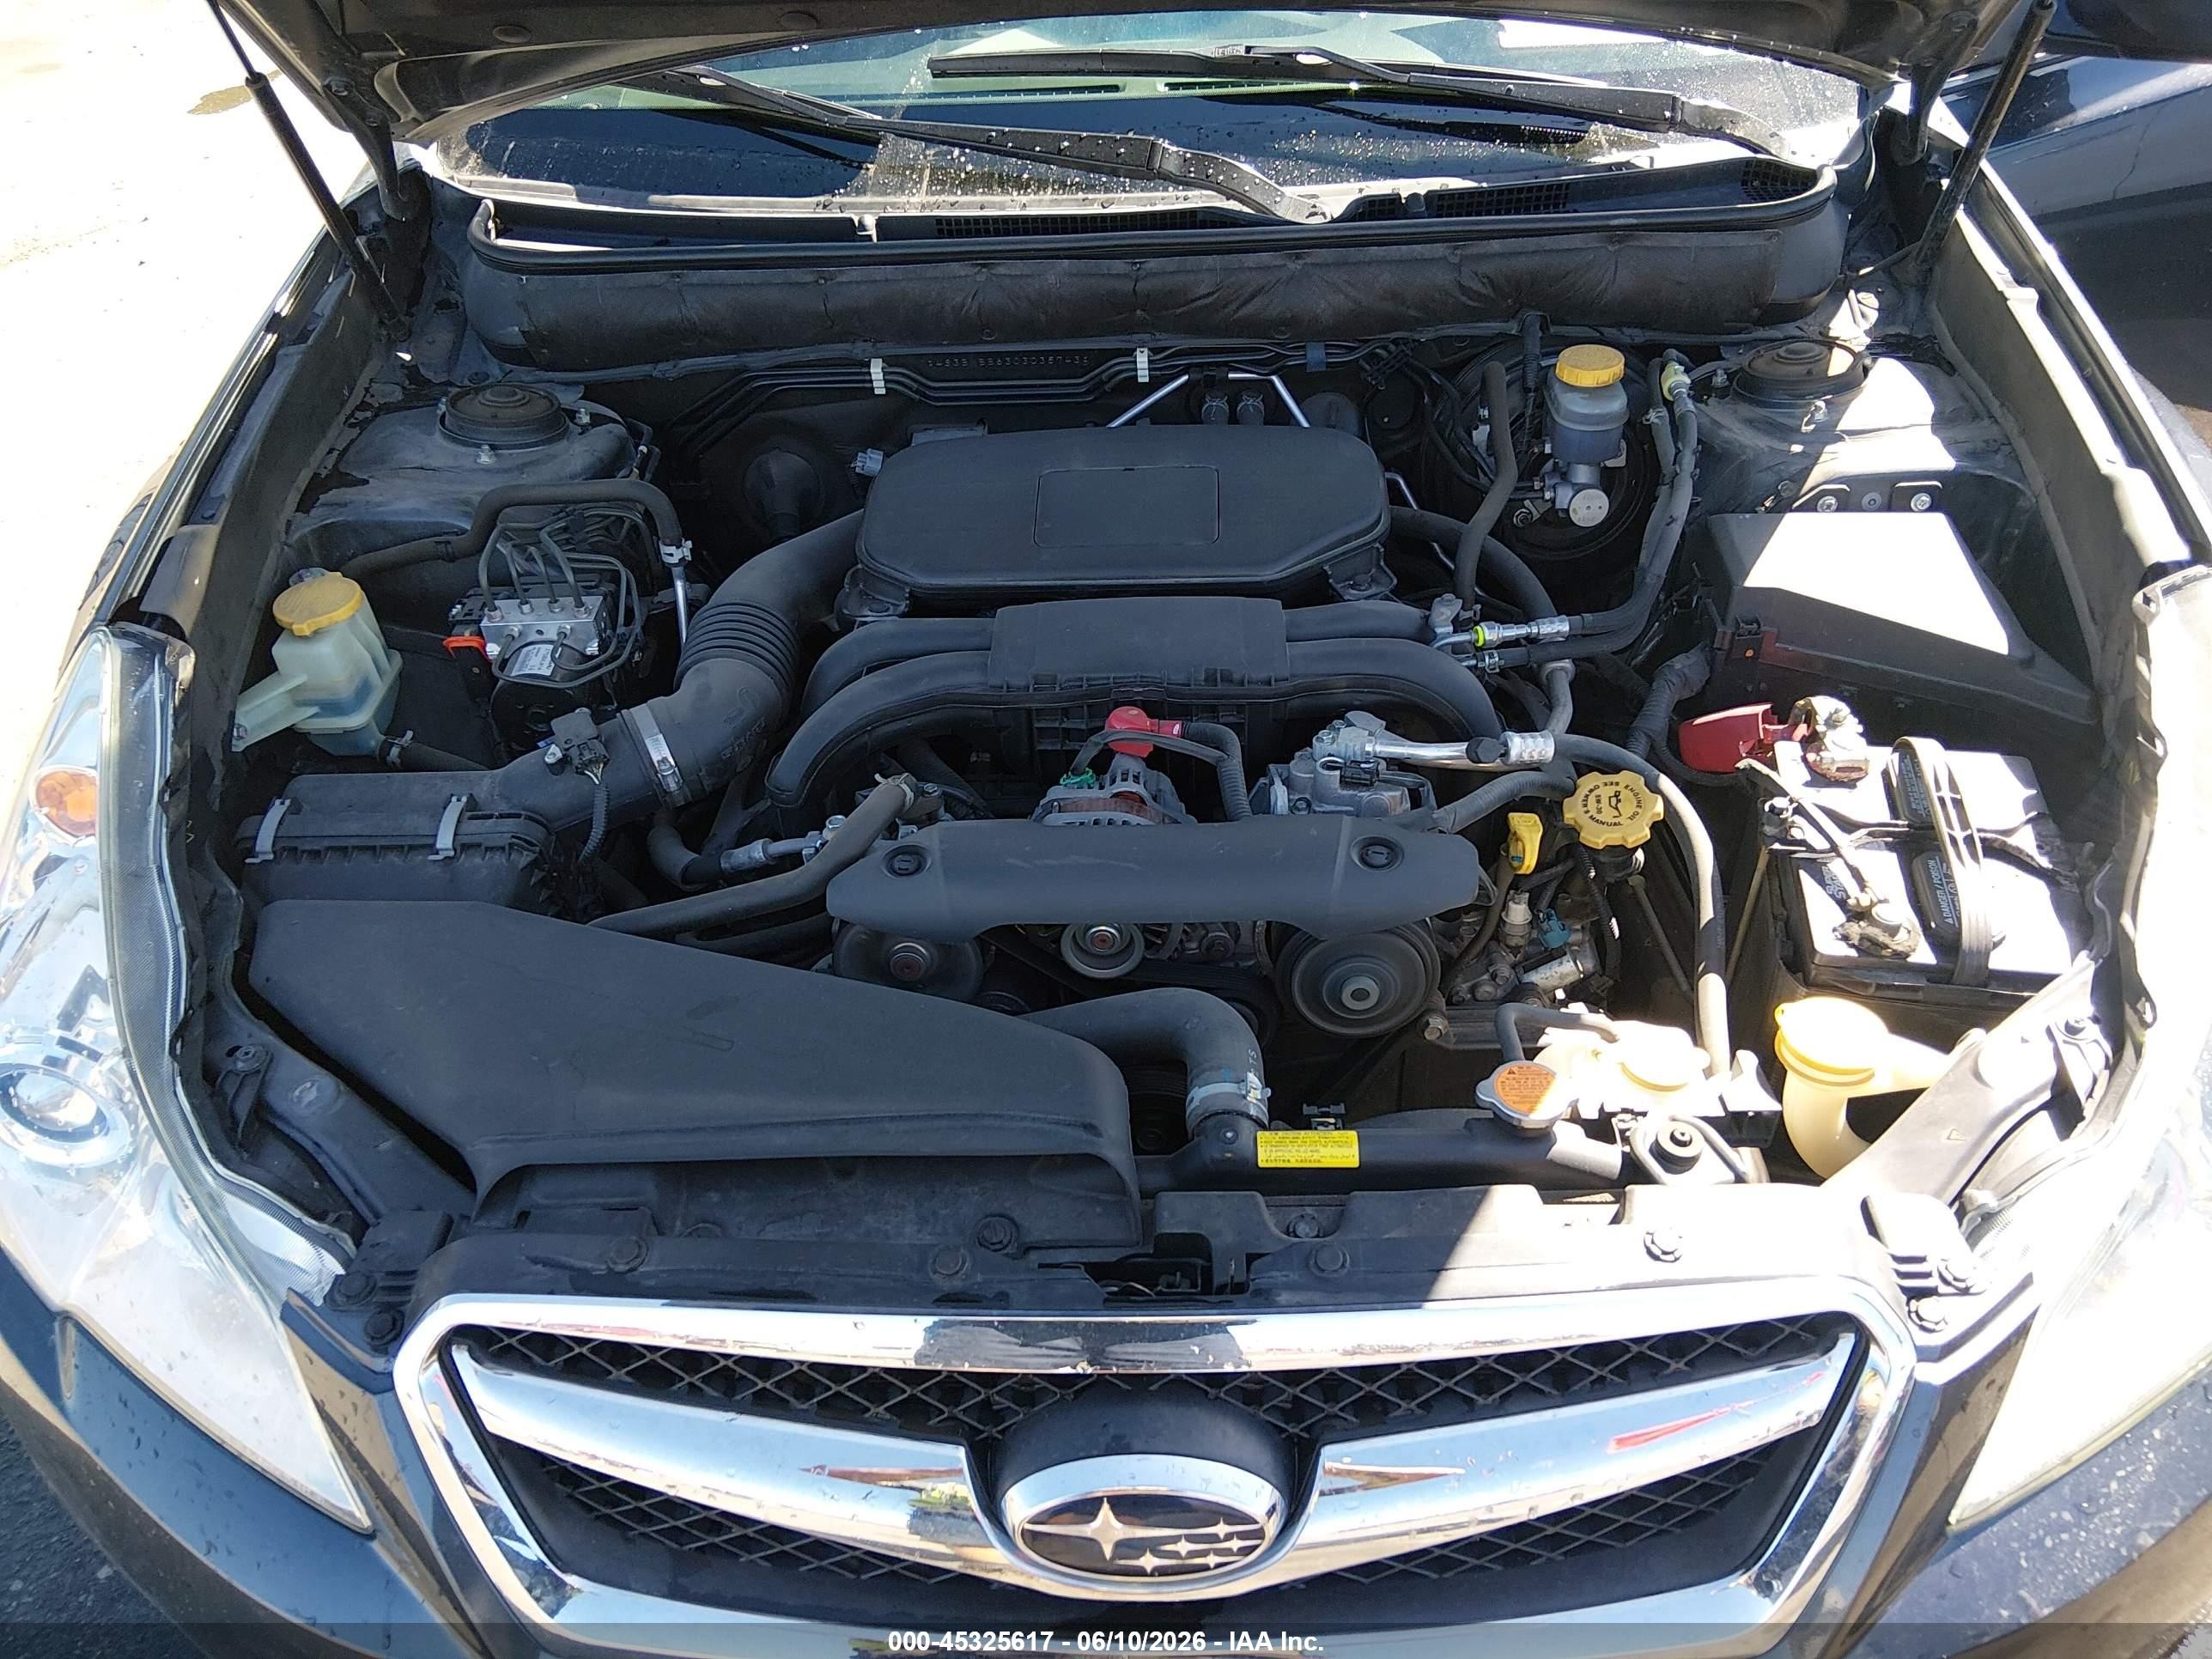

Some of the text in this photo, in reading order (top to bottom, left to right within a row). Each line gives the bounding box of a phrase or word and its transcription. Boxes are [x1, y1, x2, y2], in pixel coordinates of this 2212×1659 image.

[1595, 793, 1603, 815] 5W-30
[1623, 783, 1644, 822] ENGINE OIL
[1588, 814, 1625, 827] MANUAL
[1927, 860, 1942, 884] POISON
[1936, 890, 1952, 917] DANGER
